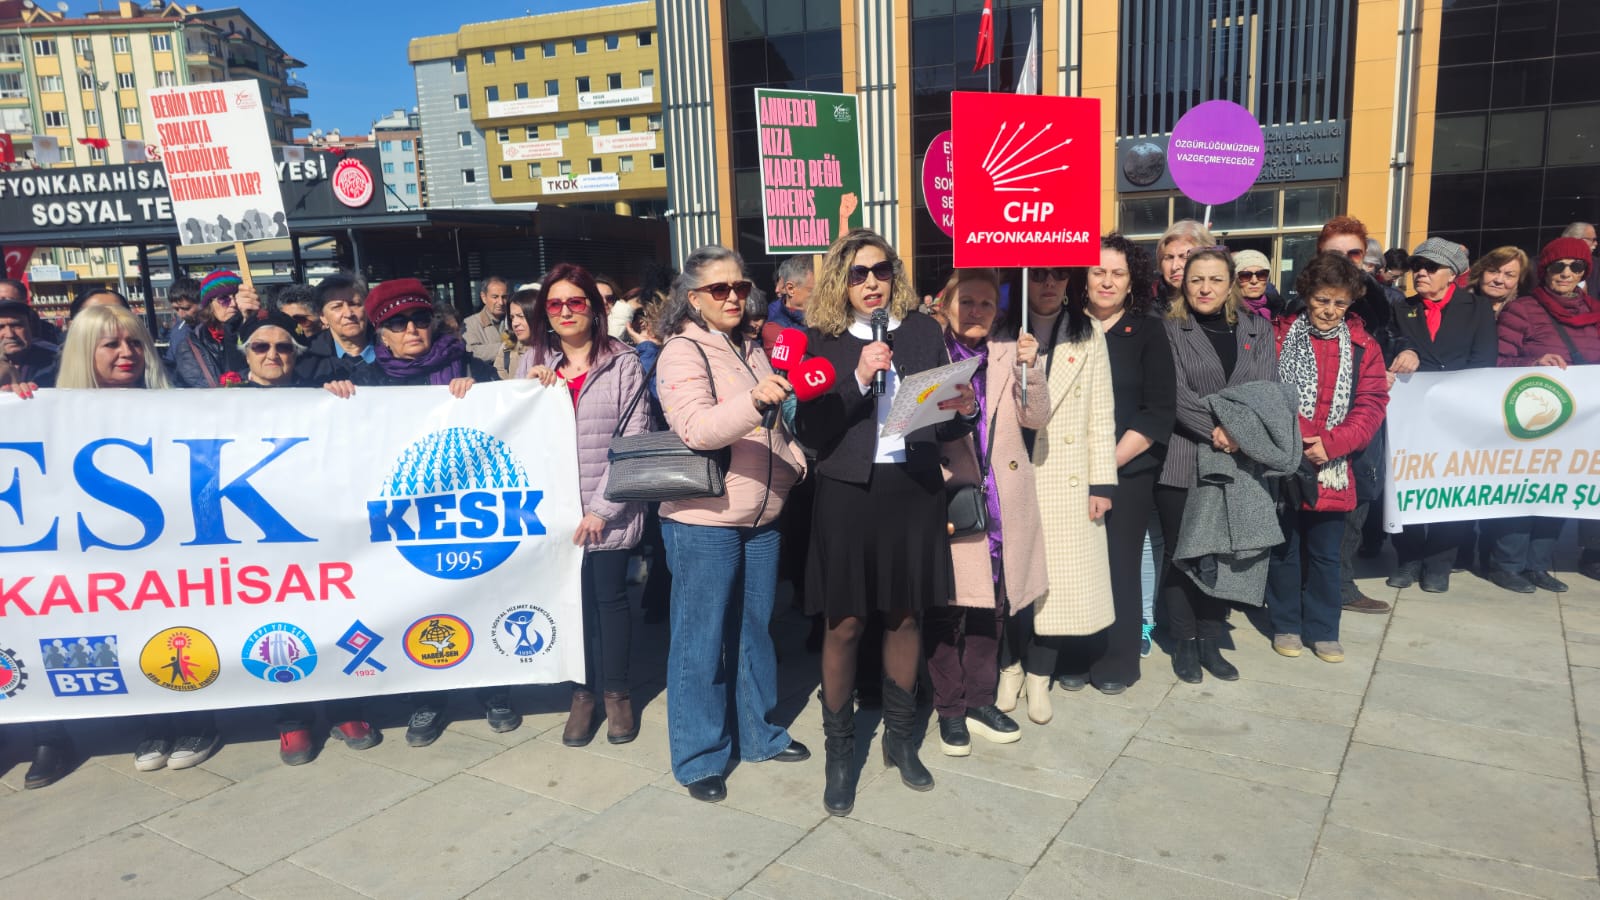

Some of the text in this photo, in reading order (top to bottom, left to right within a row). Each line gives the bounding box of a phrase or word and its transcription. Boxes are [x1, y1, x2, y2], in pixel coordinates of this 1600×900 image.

[150, 89, 189, 119] BENİM
[189, 89, 228, 116] NEDEN
[760, 96, 817, 127] ANNEDEN
[157, 120, 212, 147] SOKAKTA
[761, 128, 792, 156] KIZA
[944, 141, 952, 154] E
[1175, 138, 1260, 153] ÖZGÜRLÜĞÜMÜZDEN
[164, 144, 232, 174] ÖLDÜRÜLME
[274, 154, 328, 182] YESİ
[764, 153, 843, 188] KADER DEĞİL
[1176, 153, 1255, 166] VAZGEÇMEYECEĞİZ
[168, 171, 262, 202] İHTİMALİM VAR?
[547, 179, 578, 191] TKDK
[32, 197, 173, 226] SOSYAL TE
[766, 186, 816, 218] DİRENİŞ
[1003, 201, 1054, 223] CHP
[768, 218, 830, 246] KALACAK!
[966, 228, 1090, 244] AFYONKARAHİSAR
[32, 294, 68, 304] KONYA
[804, 370, 826, 387] 3
[1442, 448, 1562, 478] ANNELER
[1567, 448, 1600, 476] DE
[1572, 483, 1600, 511] ŞU
[367, 490, 547, 543] KESK
[435, 550, 483, 572] 1995
[0, 557, 356, 618] KARAHİSAR
[54, 672, 120, 693] BTS
[355, 669, 376, 678] 1992
